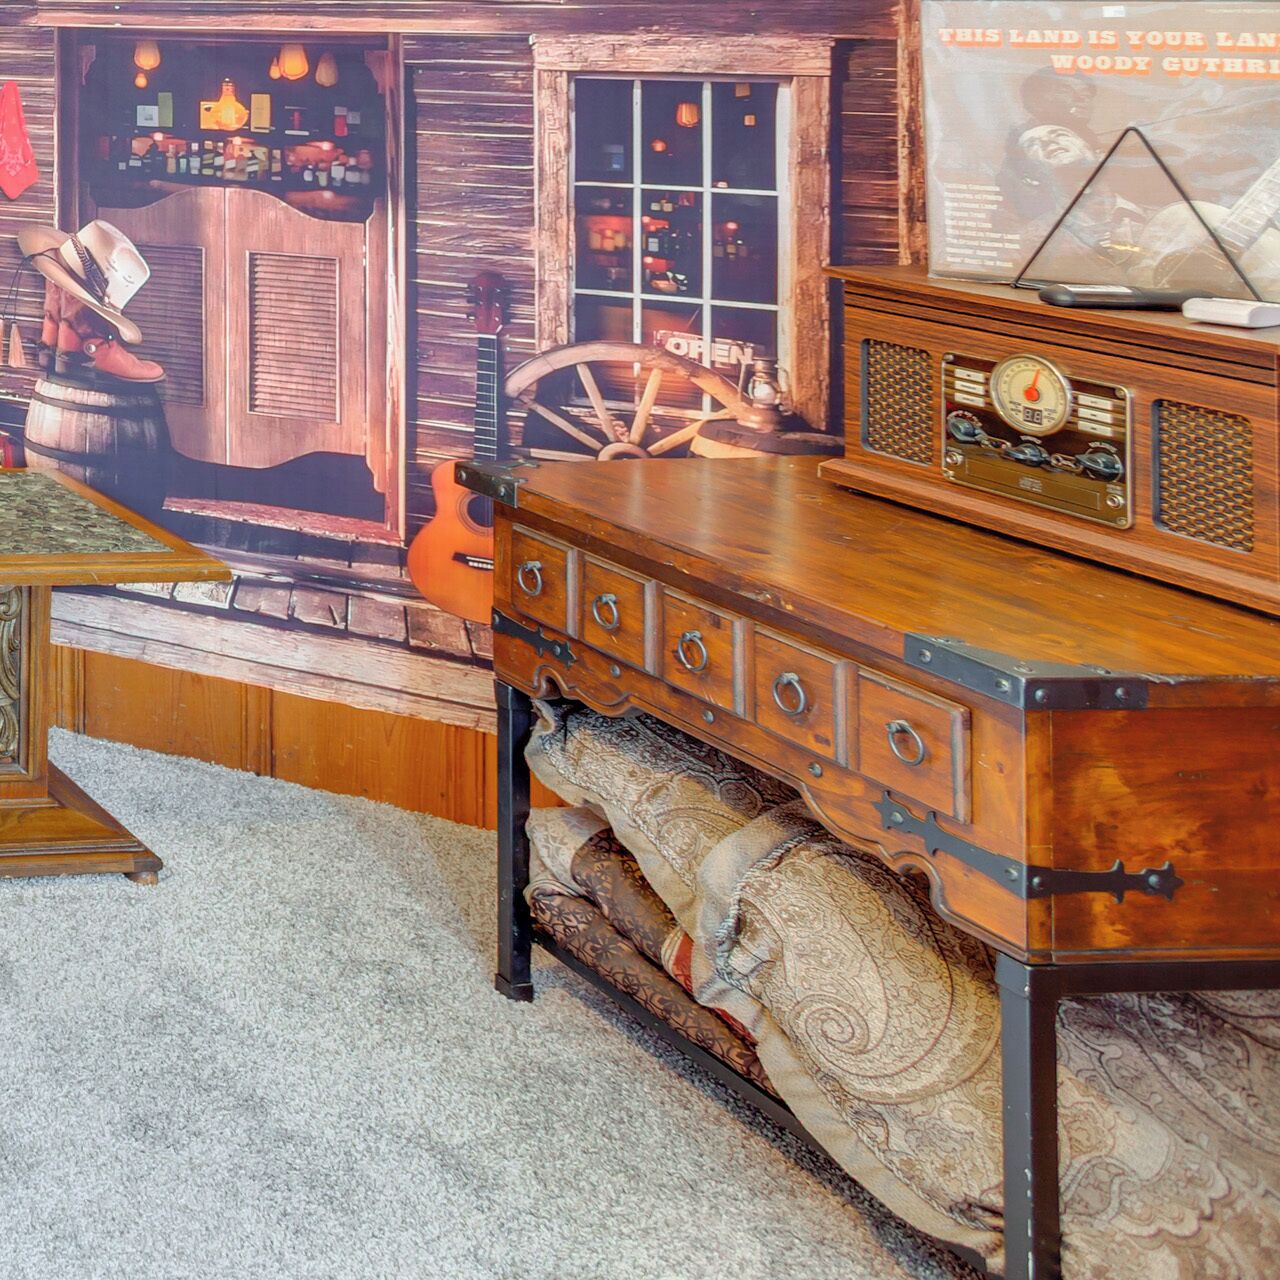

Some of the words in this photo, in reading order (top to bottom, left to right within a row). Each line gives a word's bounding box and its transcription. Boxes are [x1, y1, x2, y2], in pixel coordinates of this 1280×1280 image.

[938, 28, 1003, 48] THIS
[1008, 29, 1083, 49] LAND
[1088, 30, 1120, 50] IS
[1126, 31, 1209, 52] YOUR
[1216, 32, 1280, 53] LAN
[1050, 54, 1153, 77] WOODY
[1162, 57, 1280, 80] GUTHRI
[665, 336, 755, 365] OPEN
